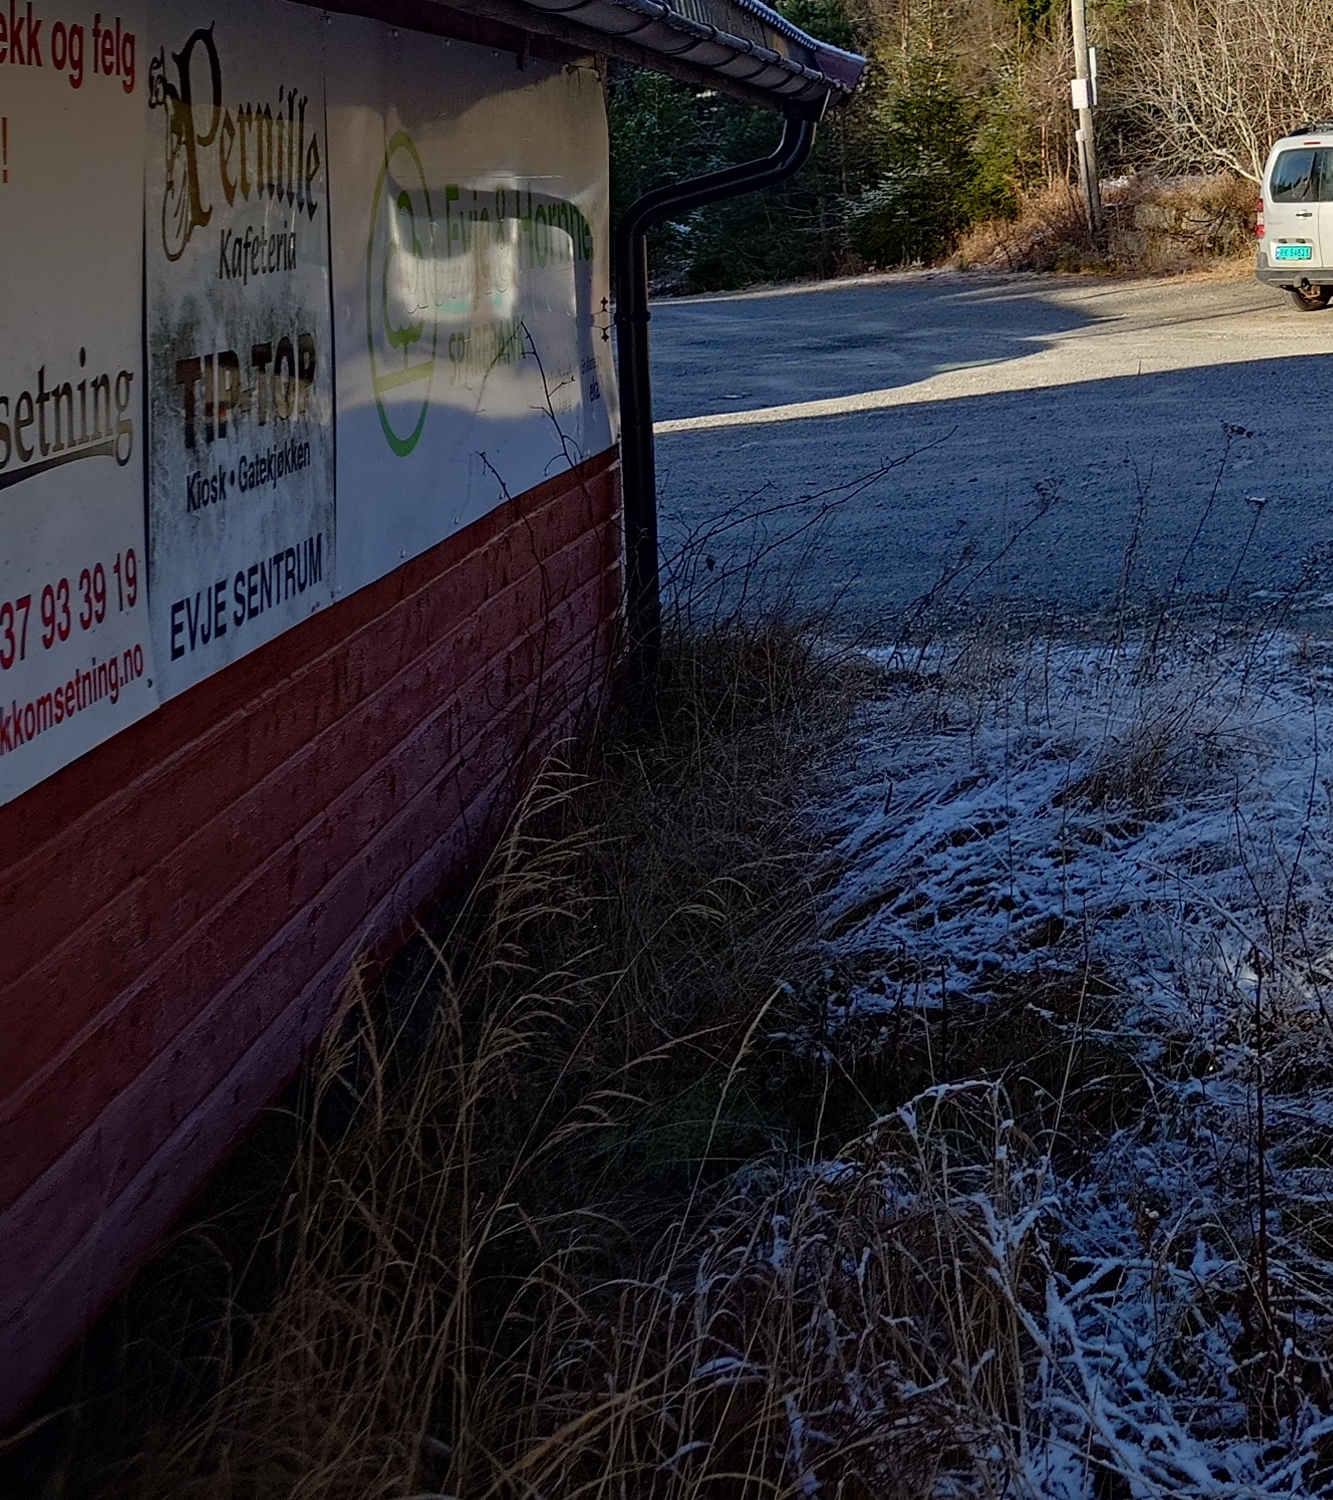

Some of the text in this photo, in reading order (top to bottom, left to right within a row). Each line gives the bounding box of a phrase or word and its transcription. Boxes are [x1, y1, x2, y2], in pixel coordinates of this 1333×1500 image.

[51, 21, 84, 89] og
[92, 13, 136, 94] felg
[165, 18, 320, 230] Pernille
[219, 220, 297, 286] Kafeteria
[0, 346, 134, 467] setning
[186, 440, 311, 513] Kiosk Gatekjøkken
[0, 548, 138, 670] 37 93 39 19
[171, 533, 323, 662] EVJE SENTRUM
[0, 643, 144, 757] kkomsetning.no
